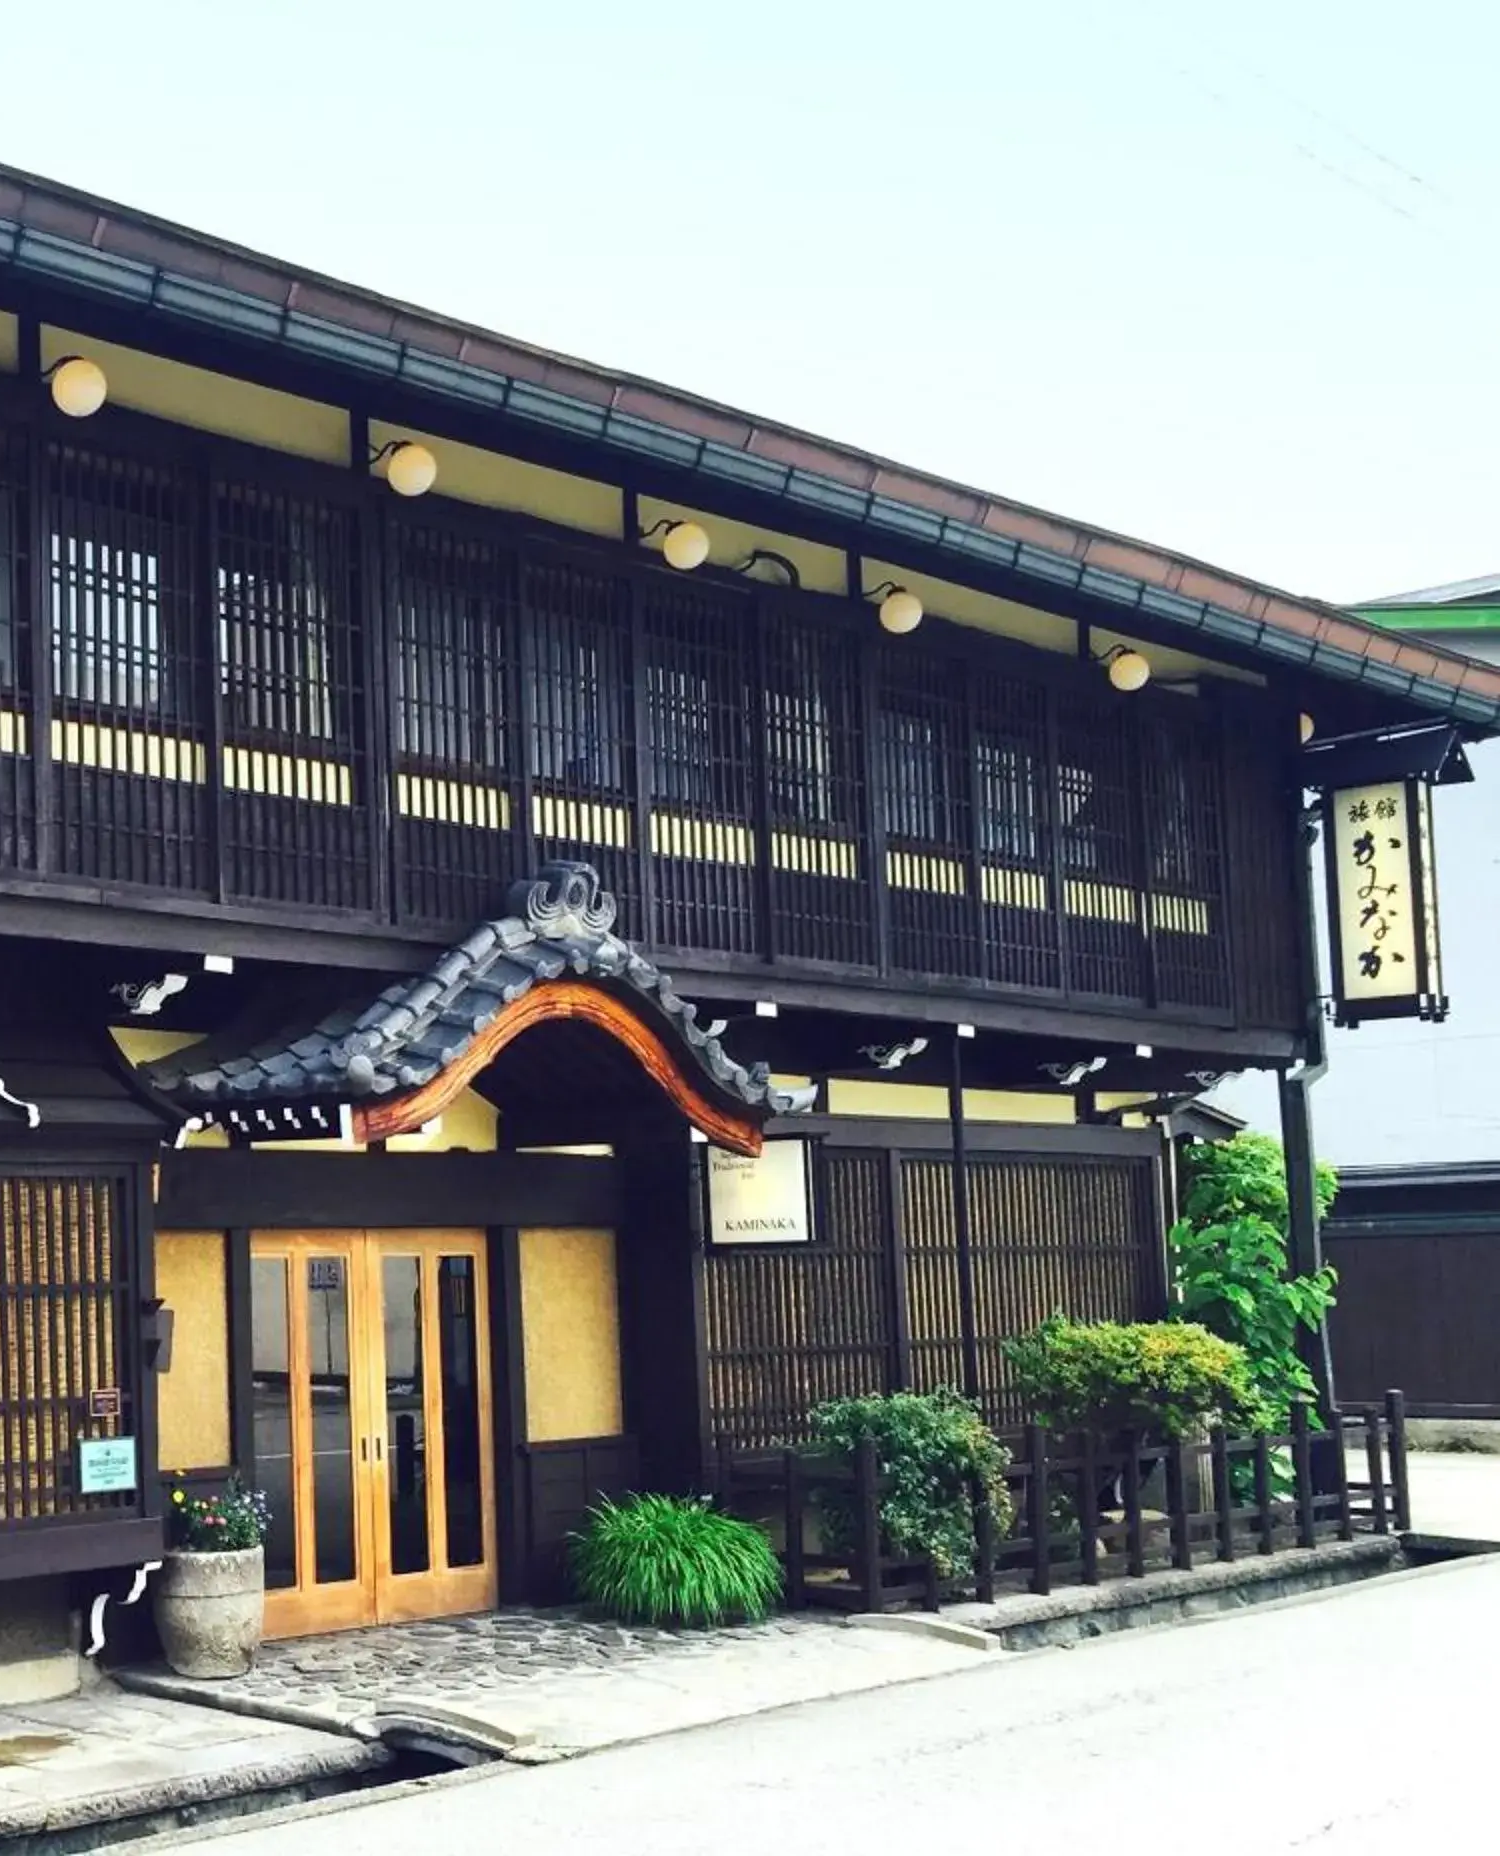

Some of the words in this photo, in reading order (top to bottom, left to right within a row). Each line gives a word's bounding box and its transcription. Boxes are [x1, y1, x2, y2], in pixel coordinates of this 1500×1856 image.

[1348, 797, 1397, 823] 旅館
[1352, 830, 1405, 979] かみなか
[724, 1217, 797, 1232] KAMINAKA
